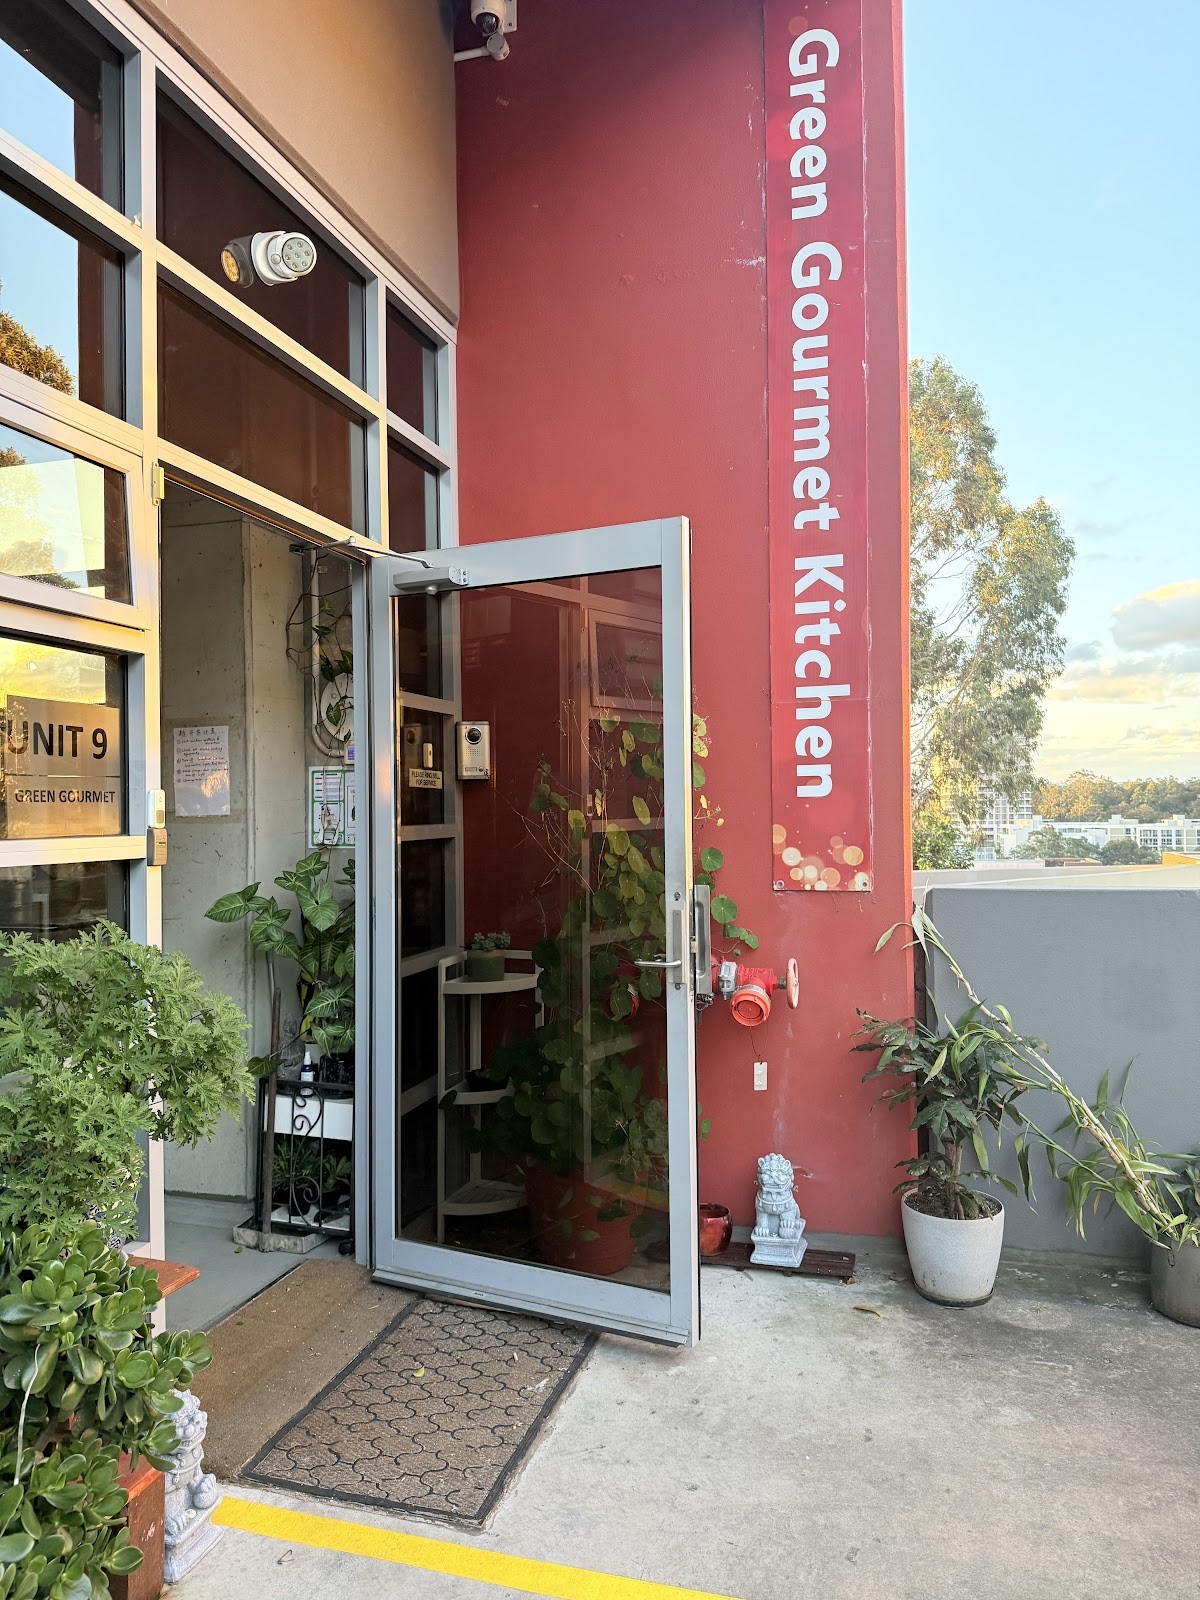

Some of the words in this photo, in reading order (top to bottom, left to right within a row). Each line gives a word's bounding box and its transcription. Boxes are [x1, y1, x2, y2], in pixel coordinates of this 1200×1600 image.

[788, 28, 840, 221] Green
[790, 241, 843, 531] Gourmet
[794, 553, 851, 798] Kitchen
[7, 719, 84, 758] UNIT
[92, 727, 108, 759] 9
[411, 770, 424, 778] PLEASE
[415, 778, 423, 786] FOR
[15, 789, 55, 803] GREEN
[59, 790, 116, 804] GOURMET
